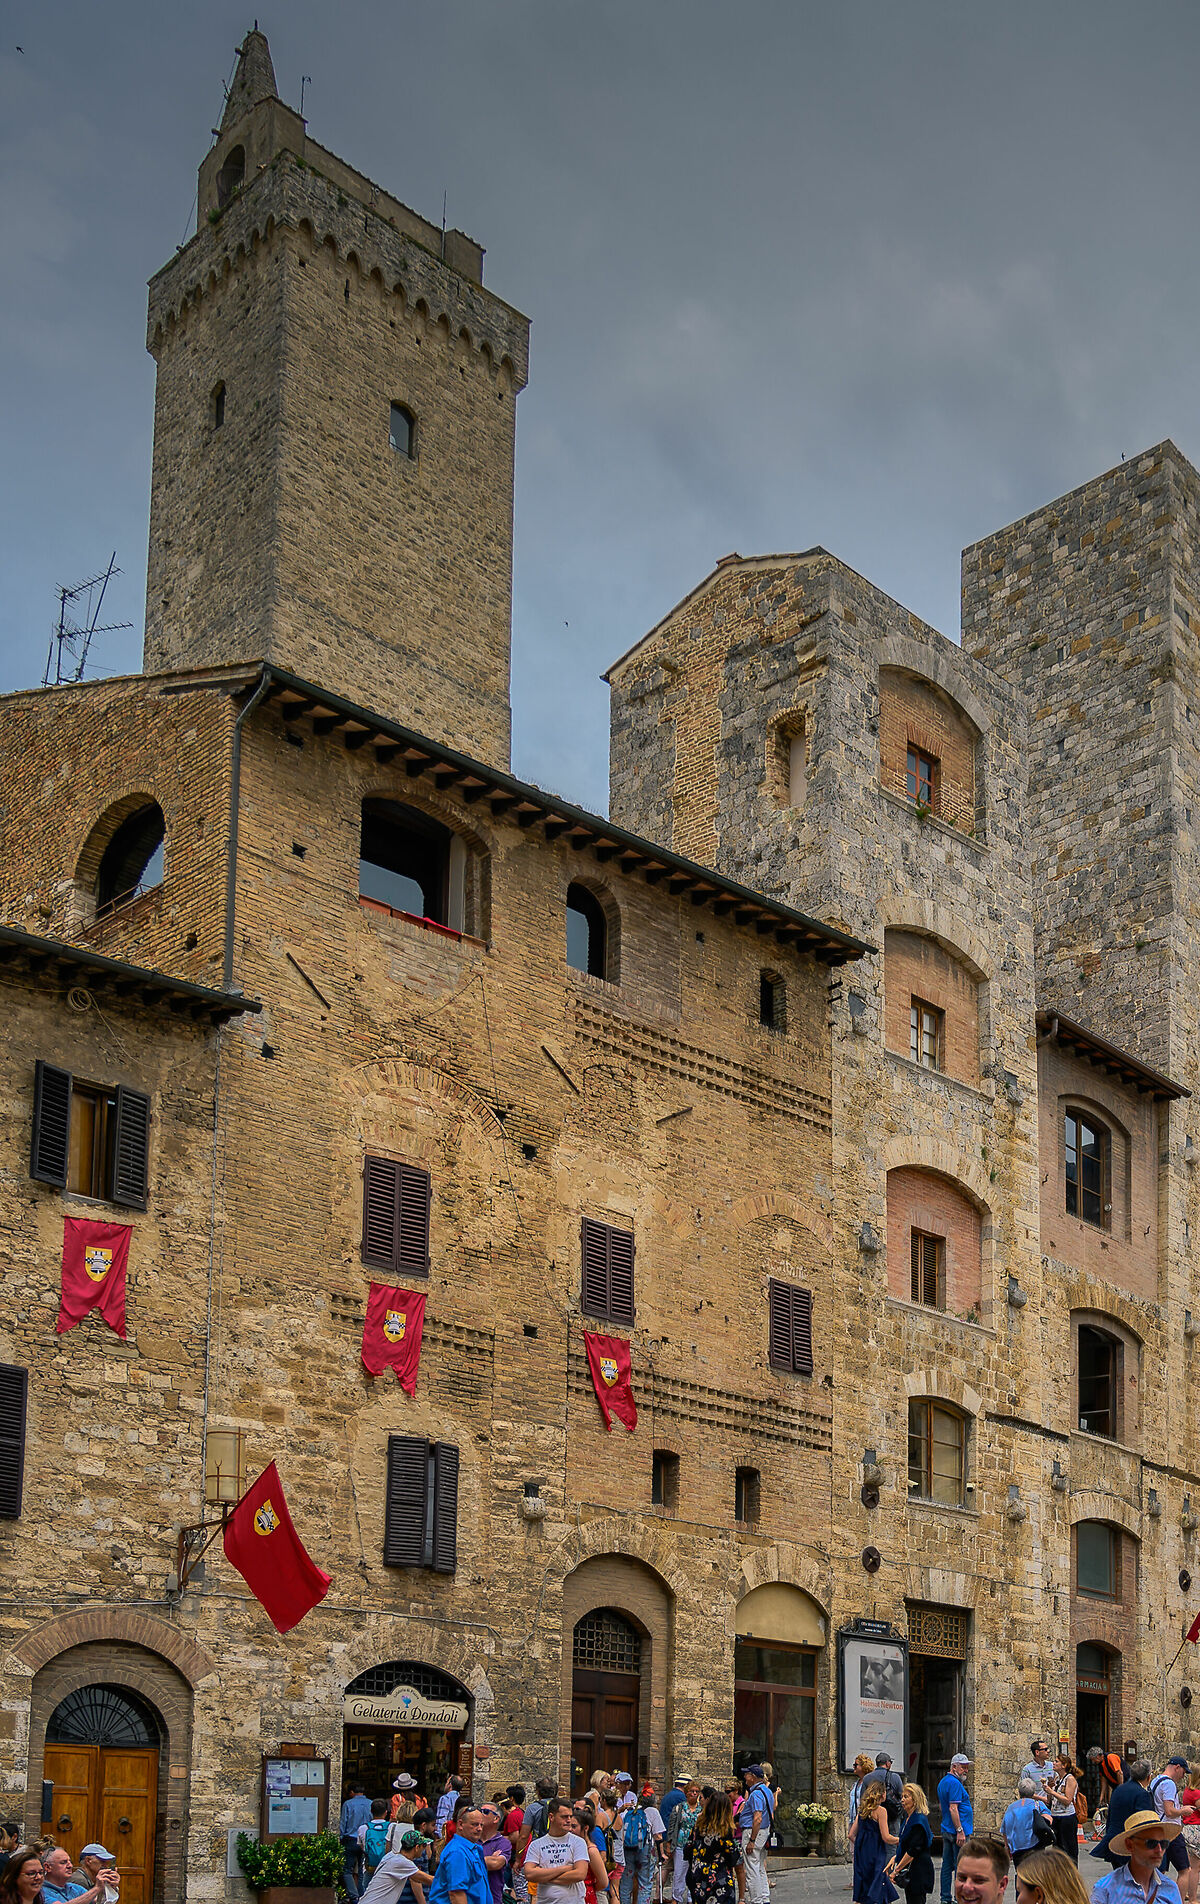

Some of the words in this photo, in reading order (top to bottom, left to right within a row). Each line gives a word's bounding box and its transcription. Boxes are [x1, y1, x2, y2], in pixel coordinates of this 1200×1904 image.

[1076, 1680, 1102, 1690] ARMACIA
[880, 1701, 903, 1710] Newton
[353, 1703, 407, 1720] Gelateria
[410, 1706, 458, 1723] Dondoli
